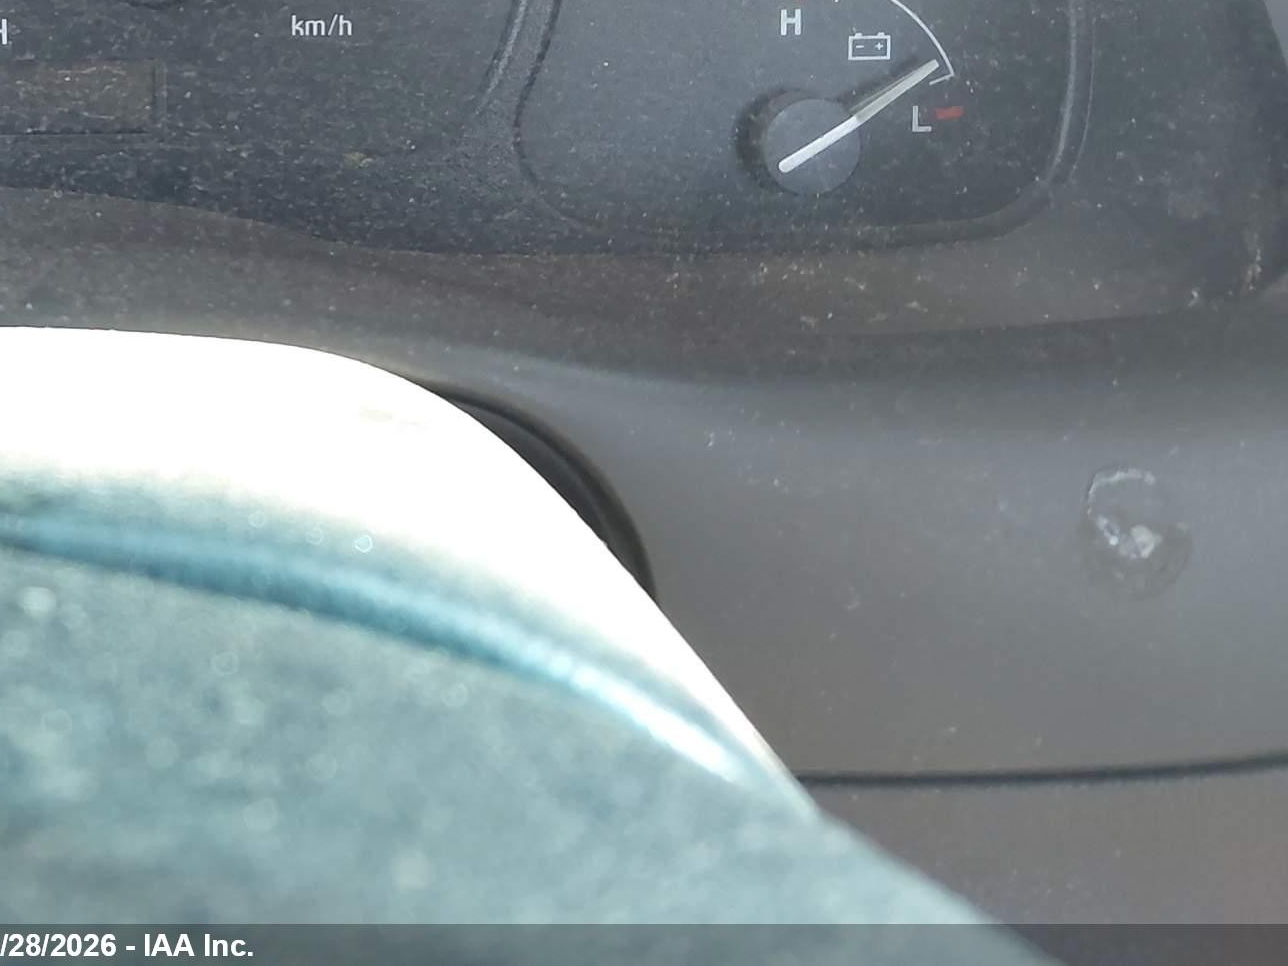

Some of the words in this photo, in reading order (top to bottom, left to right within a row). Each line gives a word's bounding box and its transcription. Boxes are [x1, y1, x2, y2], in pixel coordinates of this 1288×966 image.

[291, 14, 353, 37] km/h
[780, 9, 802, 35] H
[913, 105, 932, 133] L
